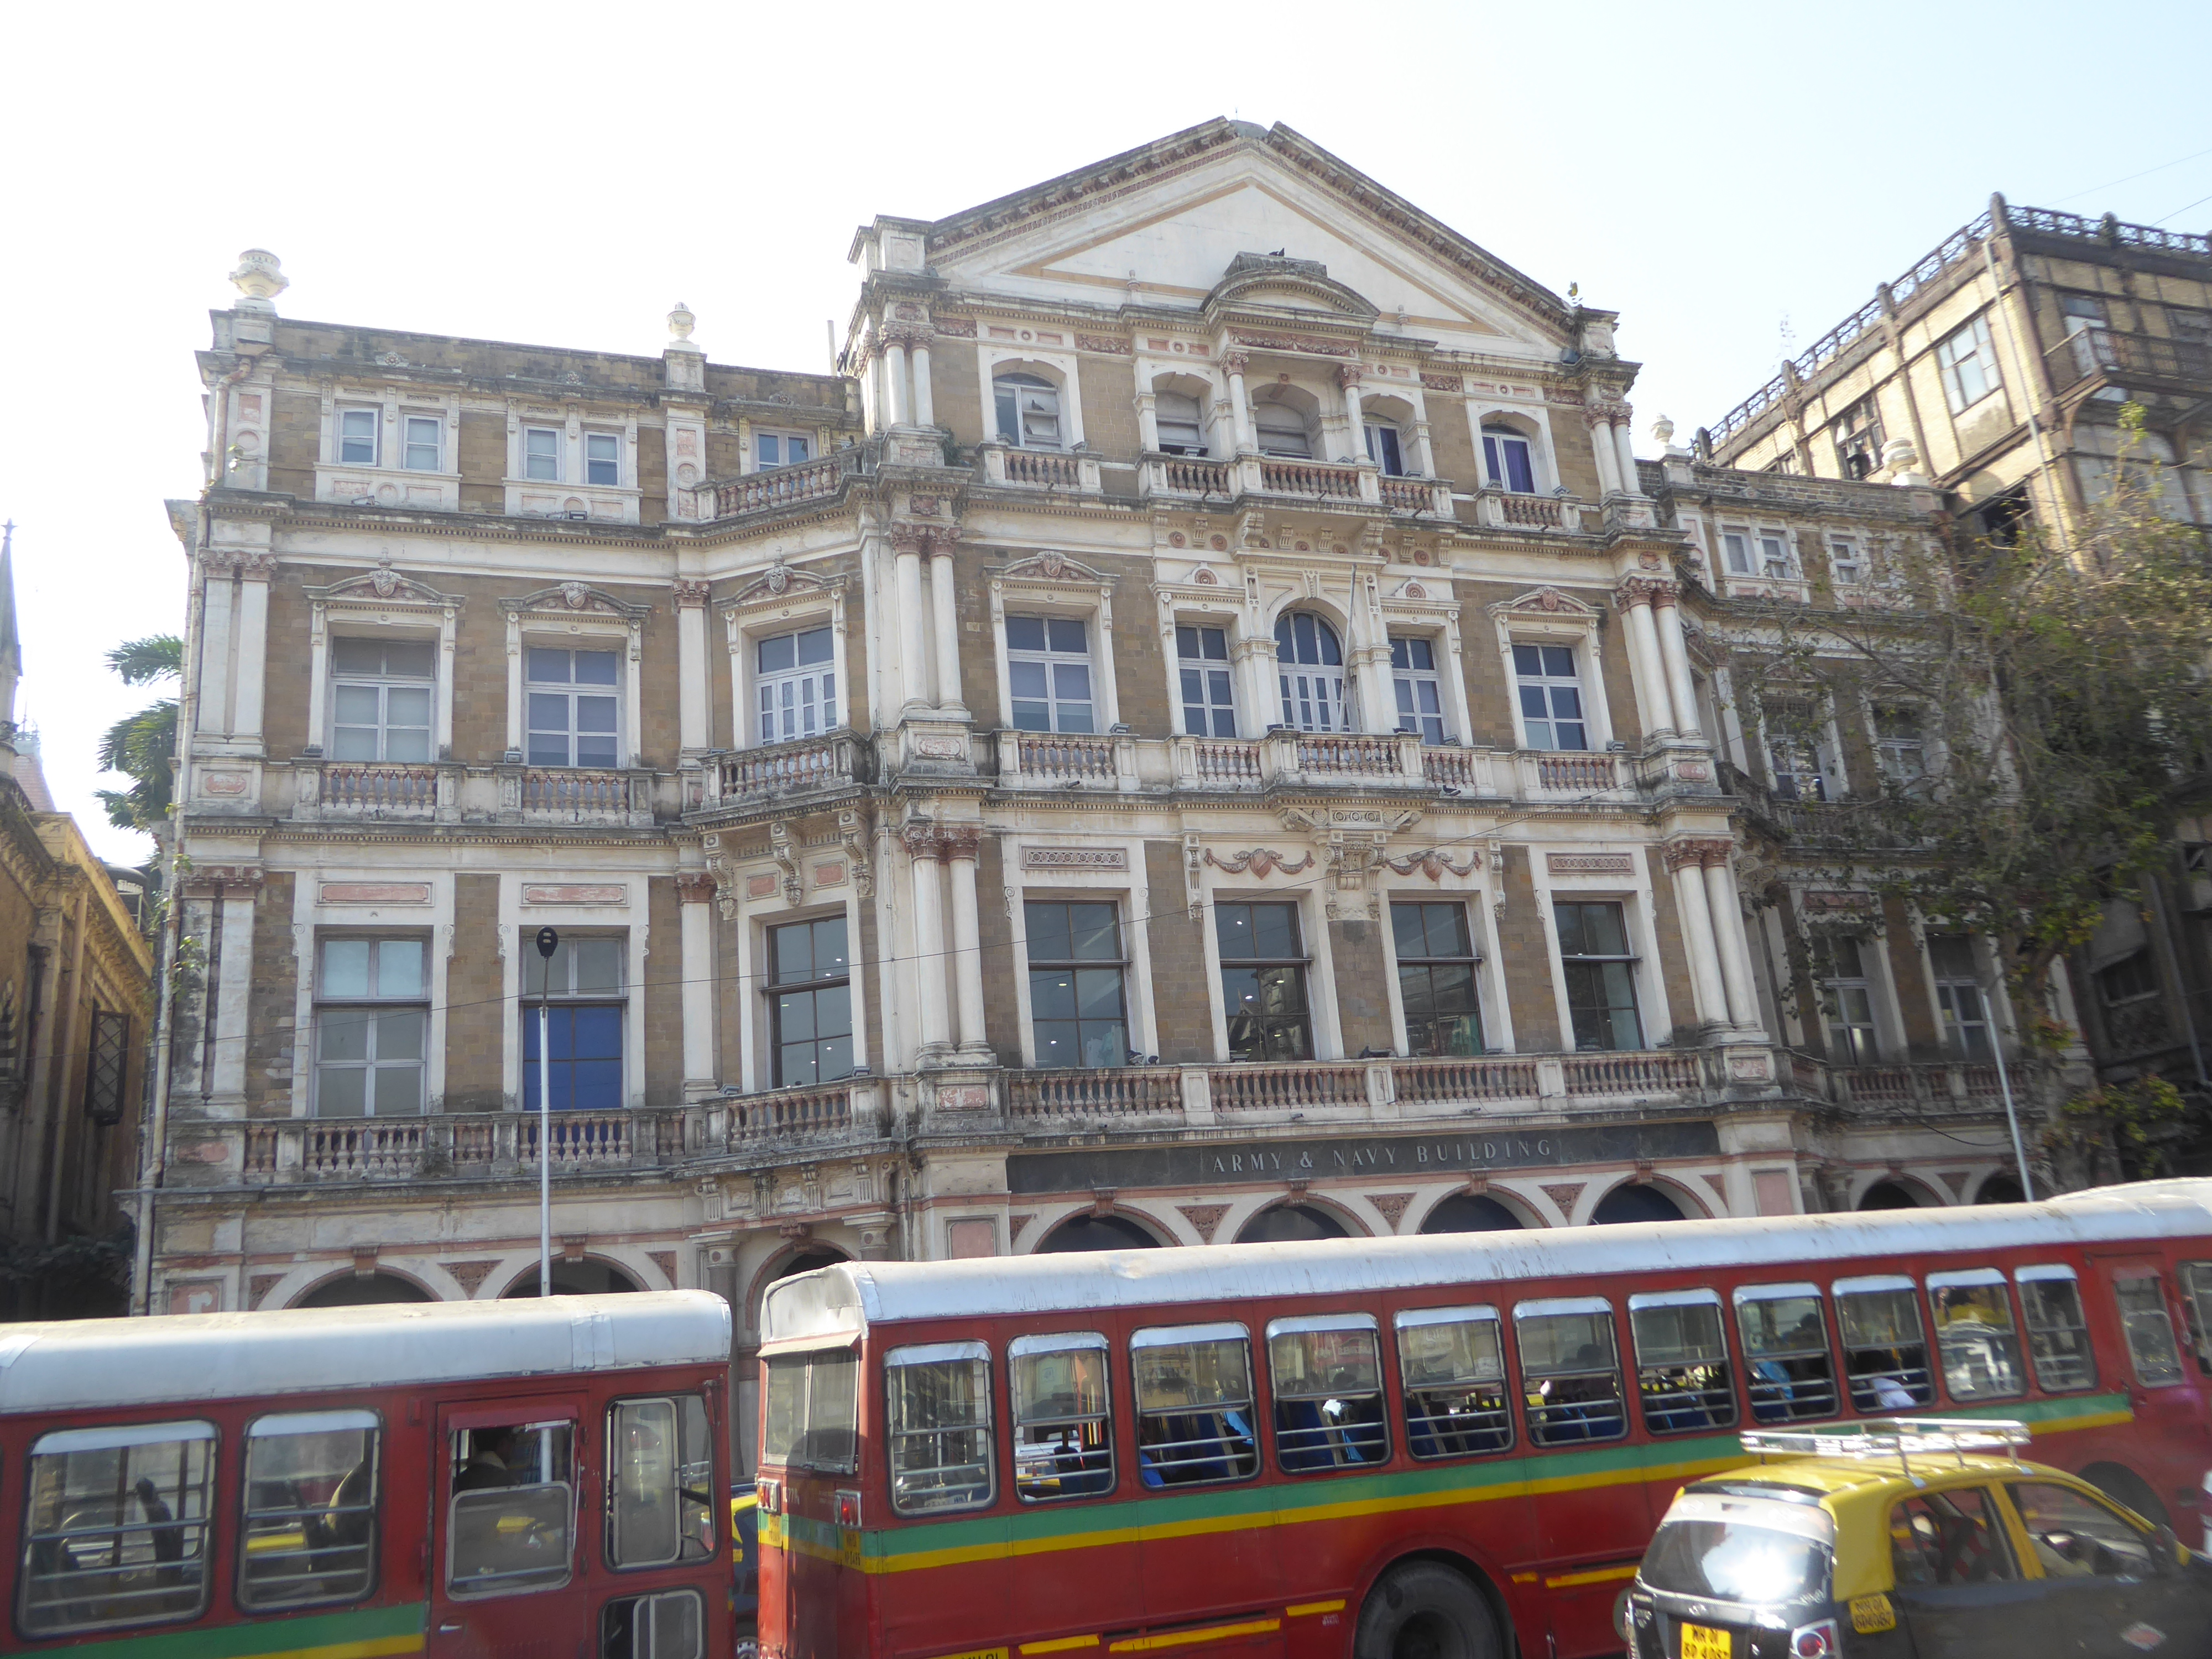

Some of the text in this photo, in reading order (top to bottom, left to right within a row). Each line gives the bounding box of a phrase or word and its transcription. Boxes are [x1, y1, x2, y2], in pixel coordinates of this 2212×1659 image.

[1213, 1139, 1550, 1173] ARMY & NAVY BUILDING
